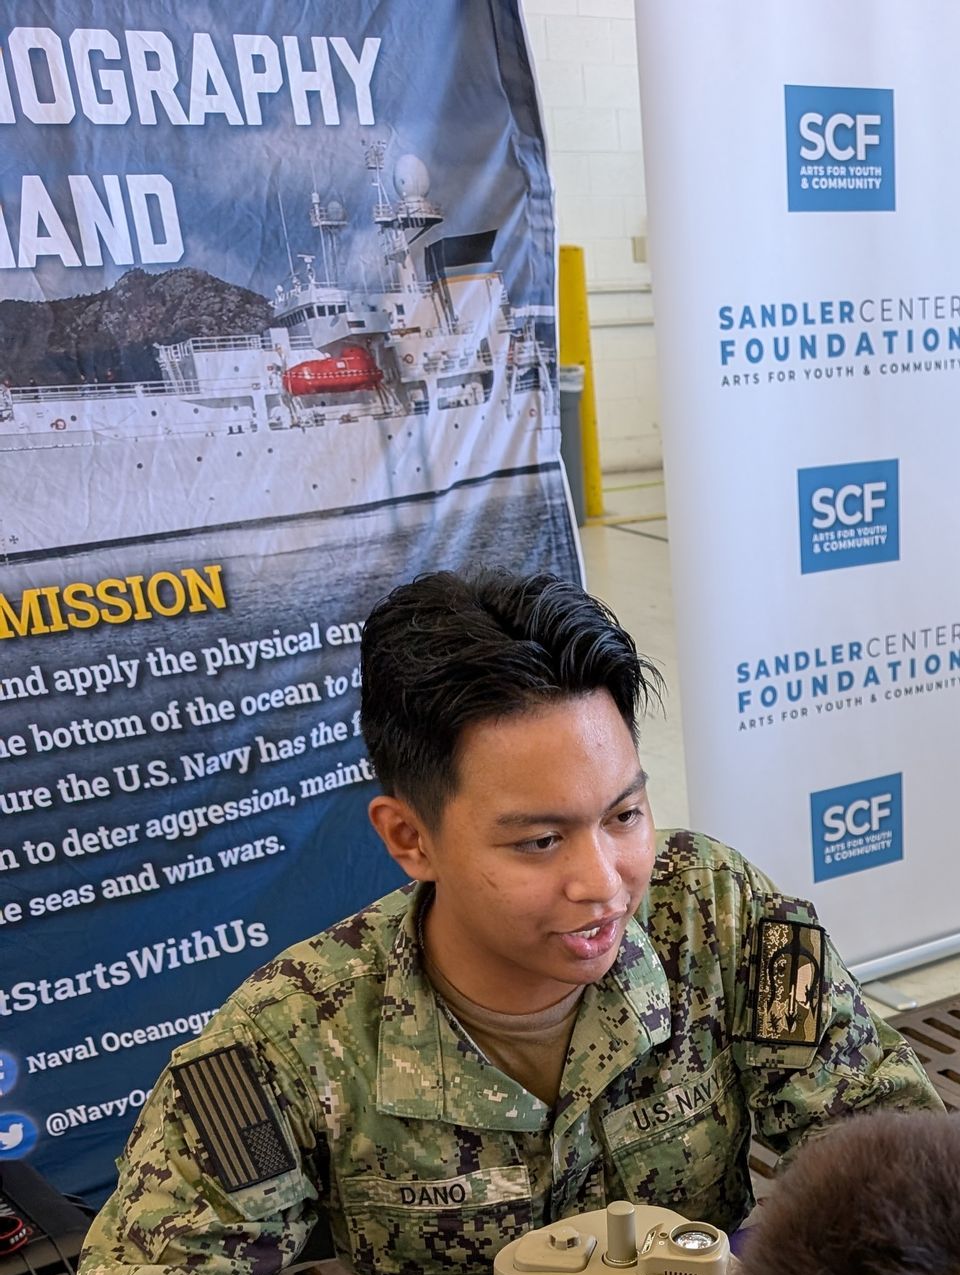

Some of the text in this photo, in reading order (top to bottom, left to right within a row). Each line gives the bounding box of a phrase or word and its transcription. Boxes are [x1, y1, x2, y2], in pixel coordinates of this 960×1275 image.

[799, 112, 881, 161] SCF
[800, 166, 882, 176] ARTS FOR YOUTH
[801, 178, 882, 189] & COMMUNITY
[0, 174, 184, 268] AND
[721, 372, 761, 387] ARTS
[768, 370, 796, 383] FOR
[804, 365, 854, 380] YOUTH
[863, 364, 871, 376] &
[812, 481, 887, 528] SCF
[813, 525, 887, 543] ARTS FOR YOUTH
[813, 535, 887, 552] & COMMUNITY
[0, 565, 226, 639] MISSION
[0, 665, 48, 700] nd
[54, 655, 139, 696] apply
[146, 648, 197, 677] the
[201, 623, 322, 675] physical
[28, 713, 146, 752] bottom
[150, 701, 183, 732] of
[186, 697, 235, 727] the
[242, 682, 321, 716] ocean
[324, 674, 348, 699] to
[739, 715, 774, 731] ARTS
[782, 707, 808, 723] FOR
[816, 696, 863, 715] YOUTH
[870, 694, 877, 705] &
[57, 773, 110, 803] the
[113, 759, 177, 793] U.S.
[182, 744, 251, 781] Navy
[255, 734, 306, 764] has
[310, 721, 348, 749] the
[23, 840, 56, 864] to
[62, 822, 140, 857] deter
[146, 789, 296, 840] aggression,
[823, 793, 891, 842] SCF
[29, 883, 96, 916] seas
[102, 864, 160, 900] and
[162, 854, 215, 885] win
[218, 833, 287, 867] wars.
[834, 840, 892, 861] COMMUNITY
[27, 1036, 98, 1074] Naval
[633, 1069, 724, 1131] U.S. NAVY
[400, 1183, 466, 1206] DANO
